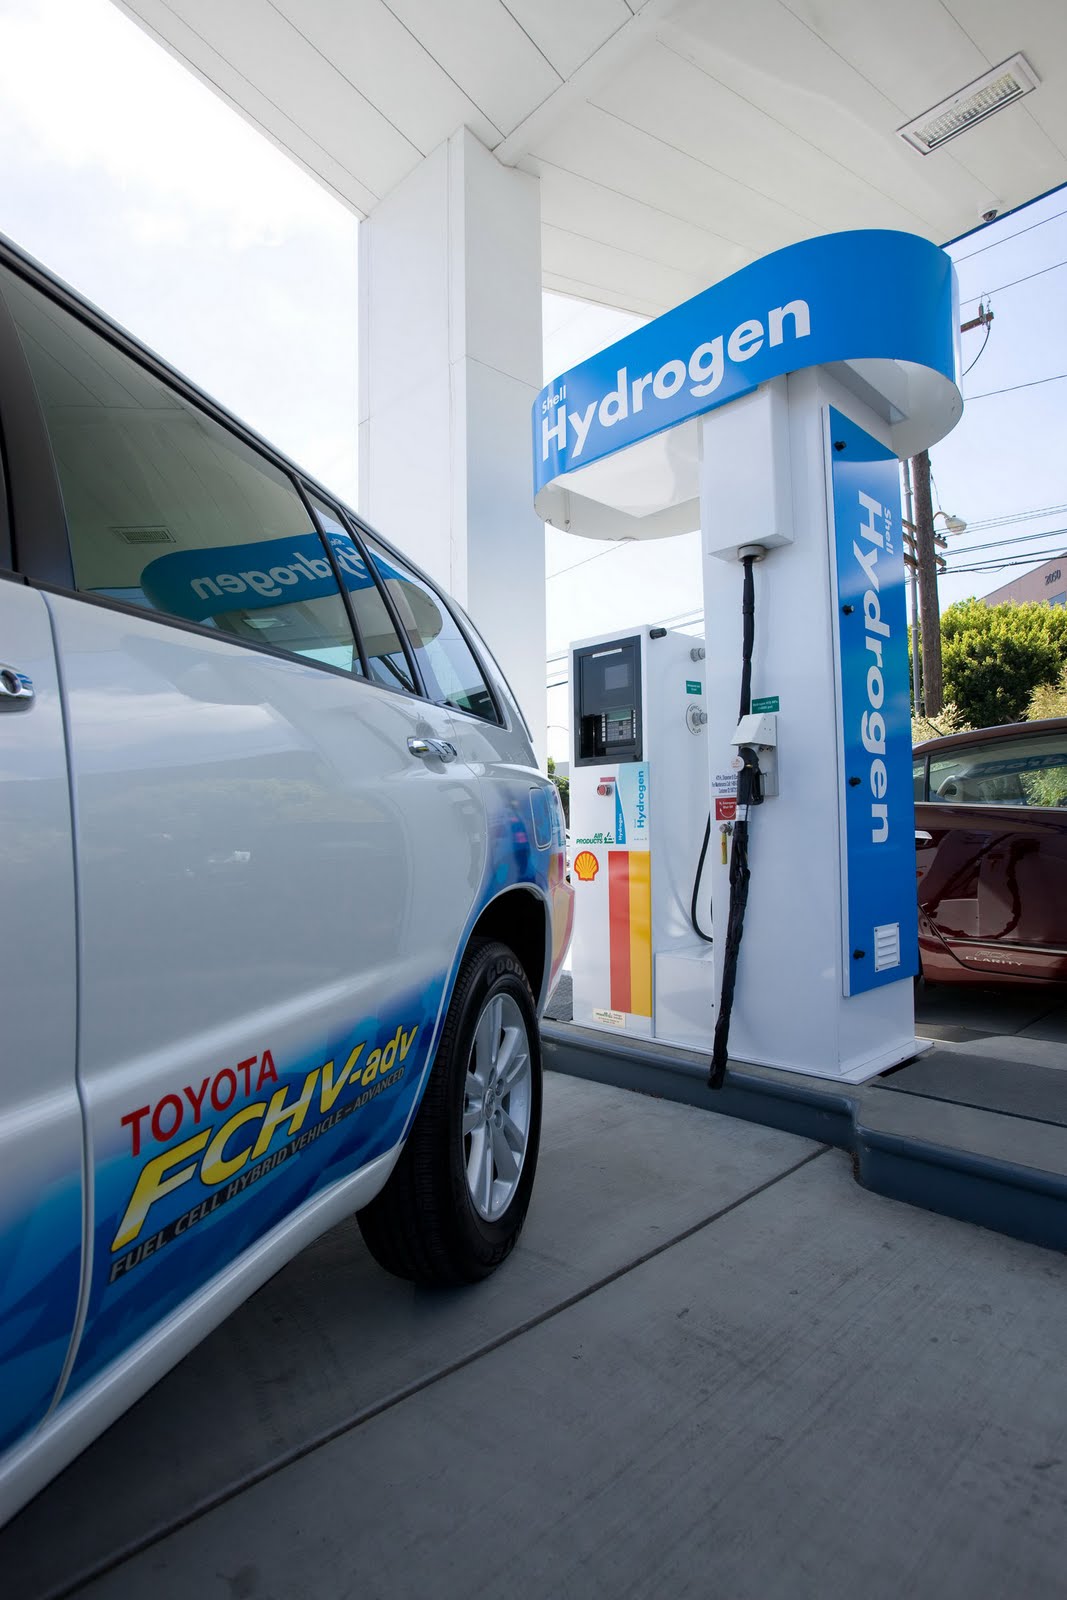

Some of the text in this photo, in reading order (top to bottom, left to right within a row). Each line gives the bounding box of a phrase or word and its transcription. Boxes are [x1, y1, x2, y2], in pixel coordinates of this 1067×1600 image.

[542, 299, 811, 462] Hydrogen
[542, 385, 567, 415] Shell
[884, 507, 894, 555] Shell
[853, 490, 890, 843] Hydrogen
[636, 770, 647, 829] Hydrogen
[965, 955, 1023, 966] CLARITY
[110, 1024, 419, 1253] FCHV-adv
[120, 1049, 279, 1157] TOYOTA
[109, 1233, 167, 1285] FUEL
[175, 1192, 221, 1236] CELL
[226, 1147, 288, 1201] HYBRID
[291, 1108, 343, 1156] VEHICLE
[354, 1066, 405, 1111] ADVANCED
